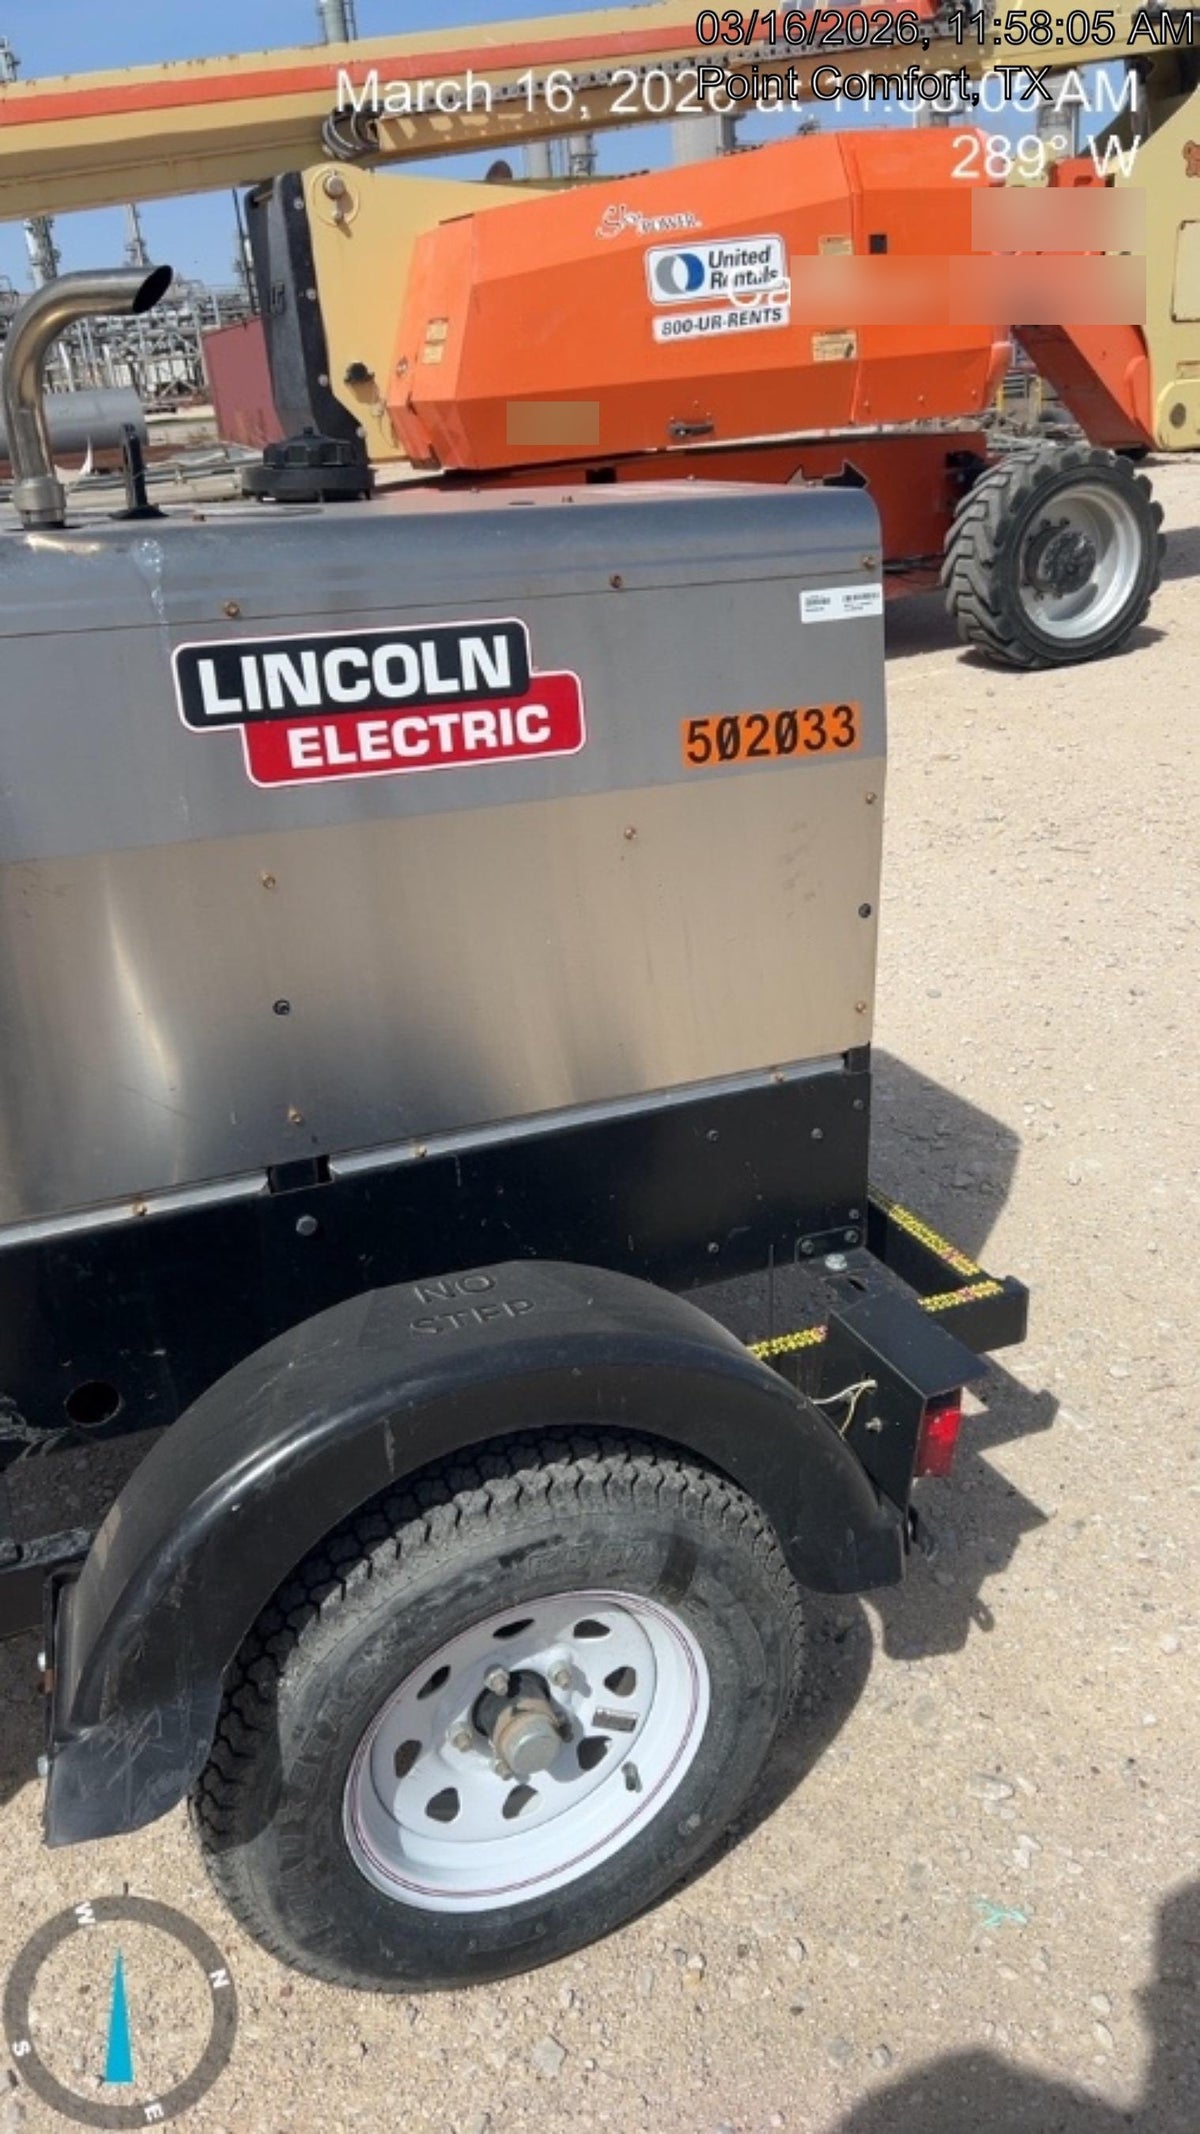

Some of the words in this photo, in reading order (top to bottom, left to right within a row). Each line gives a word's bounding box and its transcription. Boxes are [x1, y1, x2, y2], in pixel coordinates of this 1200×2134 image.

[709, 245, 771, 269] United
[661, 307, 782, 335] 800-UR-RENTS
[197, 635, 512, 716] LINCOLN
[287, 704, 551, 769] ELECTRIC
[687, 704, 855, 764] 502033
[414, 1275, 497, 1304] NO
[410, 1299, 536, 1336] STEP
